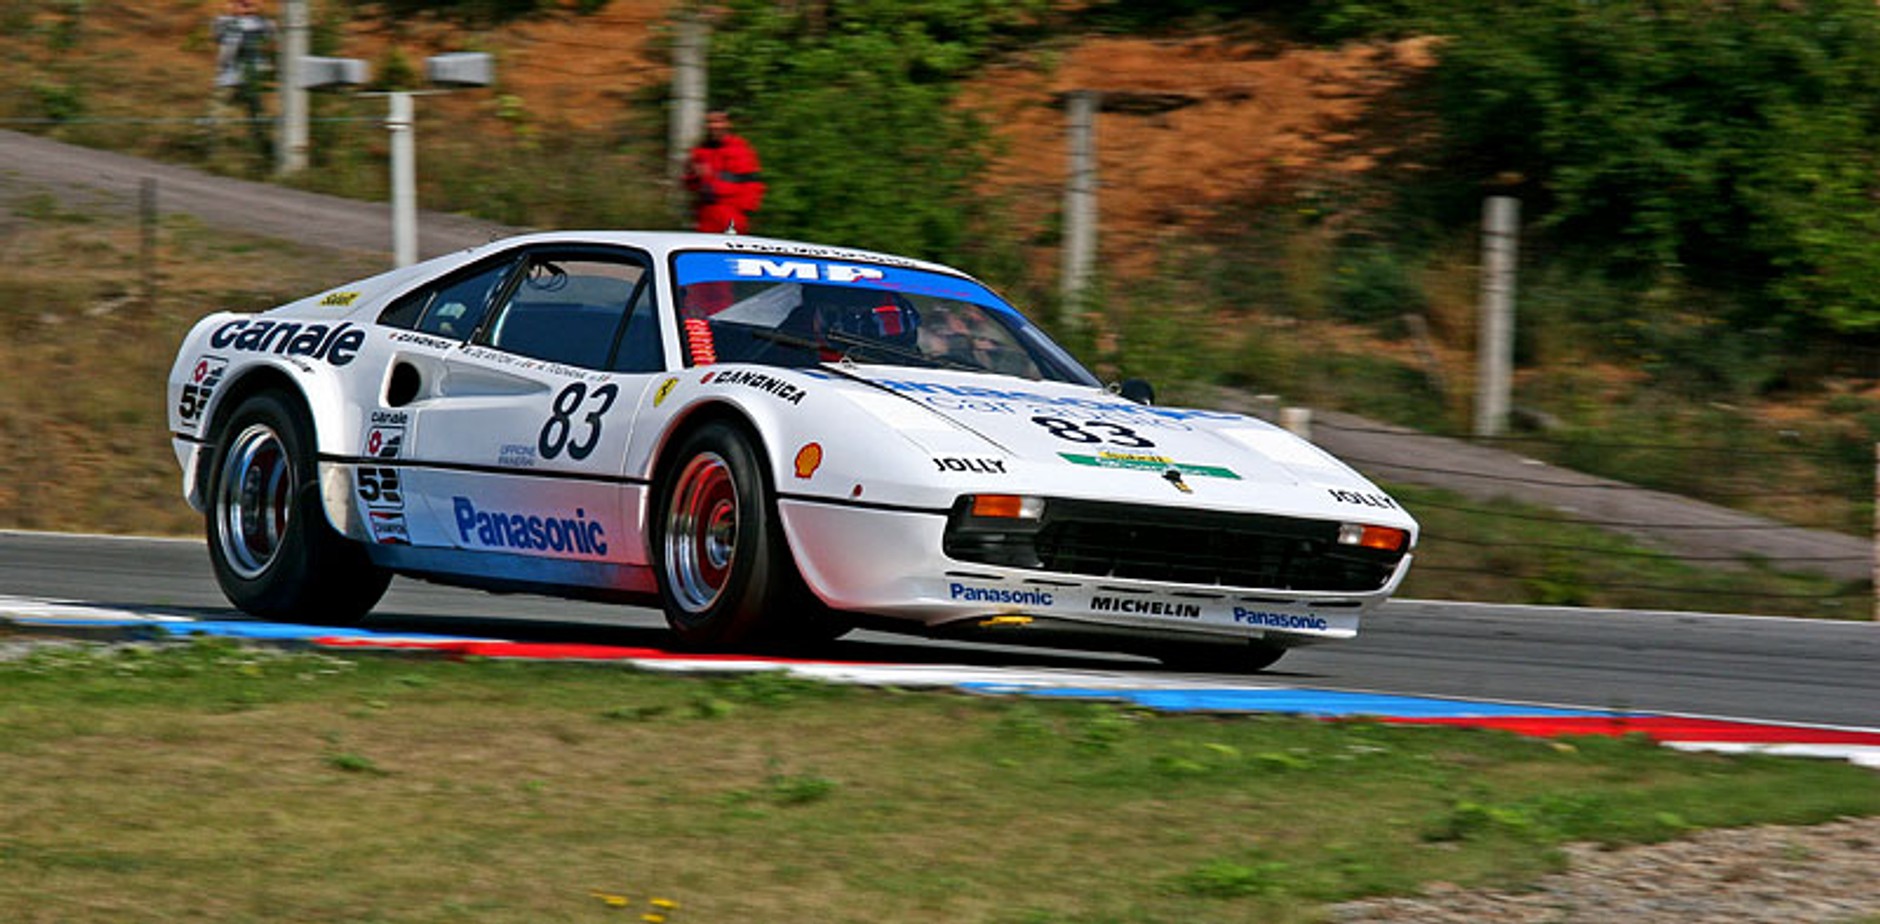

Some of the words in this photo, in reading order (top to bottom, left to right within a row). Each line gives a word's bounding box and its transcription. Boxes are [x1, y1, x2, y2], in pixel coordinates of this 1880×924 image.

[732, 257, 883, 280] MP
[209, 318, 367, 366] canale
[714, 370, 806, 405] CANONICA
[371, 412, 408, 424] canale
[538, 382, 619, 461] 83
[1031, 416, 1156, 449] 83
[932, 457, 1007, 476] JOLLY
[1327, 487, 1397, 511] JOLLY
[453, 496, 608, 557] Panasonic
[949, 582, 1054, 608] Panasonic
[1090, 596, 1201, 619] MICHELIN
[1233, 606, 1328, 631] Panasonic
